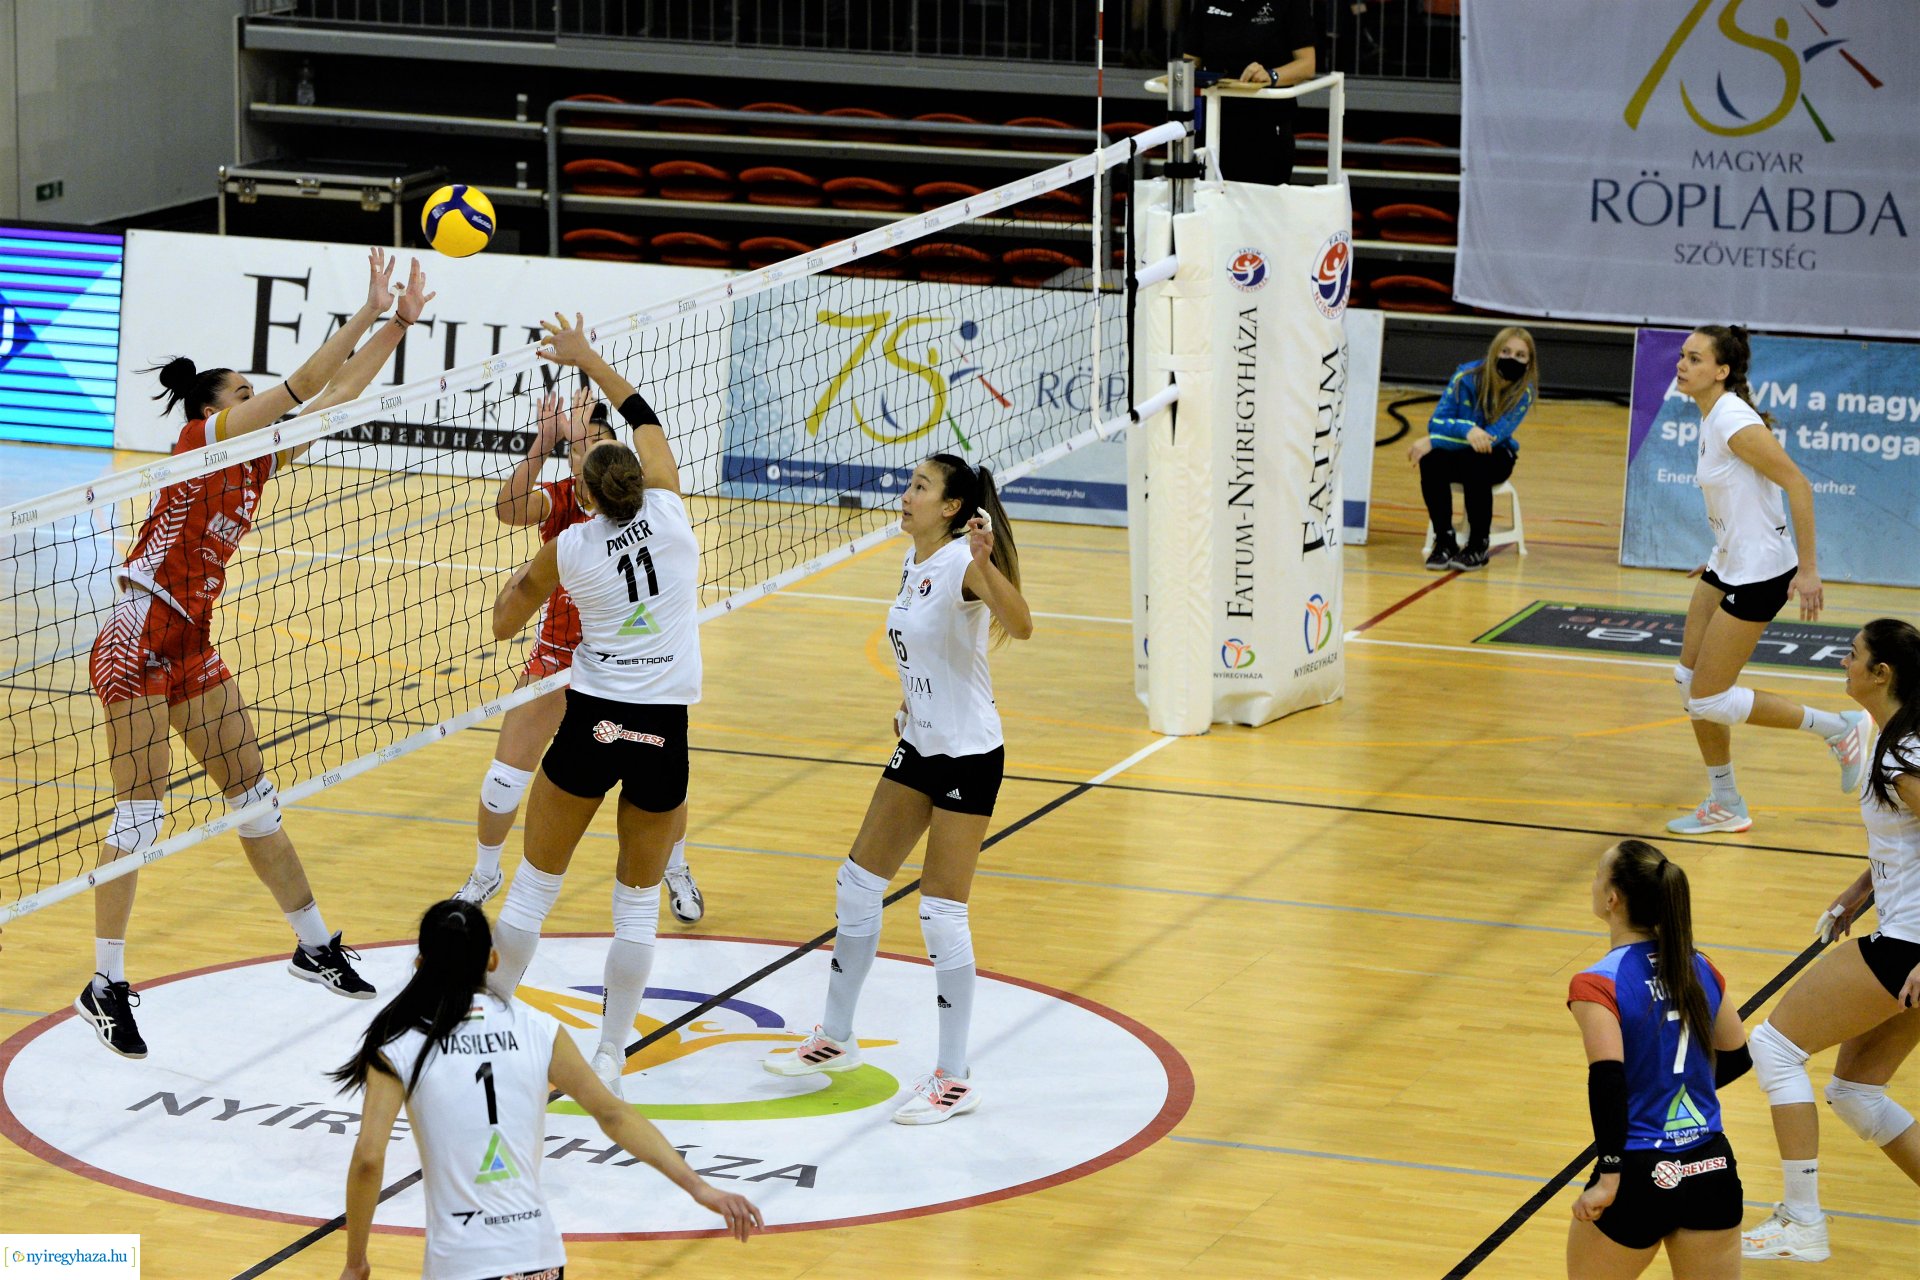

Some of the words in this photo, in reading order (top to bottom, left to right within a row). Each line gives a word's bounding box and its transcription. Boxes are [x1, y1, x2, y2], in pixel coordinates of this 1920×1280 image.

[1692, 150, 1804, 174] MAGYAR
[1590, 170, 1908, 238] RÖPLABDA
[1674, 241, 1817, 272] SZÖVETSÉG
[678, 299, 697, 314] FATUM
[380, 395, 402, 412] FATUM
[1807, 391, 1827, 411] a
[204, 450, 228, 467] FATUM
[1004, 485, 1086, 500] www.humvolley.hu
[11, 509, 38, 527] FATUM
[606, 519, 653, 557] PINTÉR
[617, 545, 660, 603] 11
[888, 628, 908, 662] 15
[616, 654, 674, 666] BESTRONG
[1294, 651, 1339, 678] NYÍREGYHÁZA
[1213, 671, 1264, 680] NYÍREGYHÁZA
[484, 704, 502, 719] FATUM
[620, 730, 665, 747] REVESZ
[322, 772, 342, 789] FATUM
[143, 848, 164, 864] FATUM
[439, 1030, 519, 1055] VASILEVA
[1667, 1010, 1691, 1074] 7
[475, 1062, 498, 1125] 1
[1682, 1157, 1727, 1176] REVESZ
[484, 1208, 542, 1226] BESTRONG
